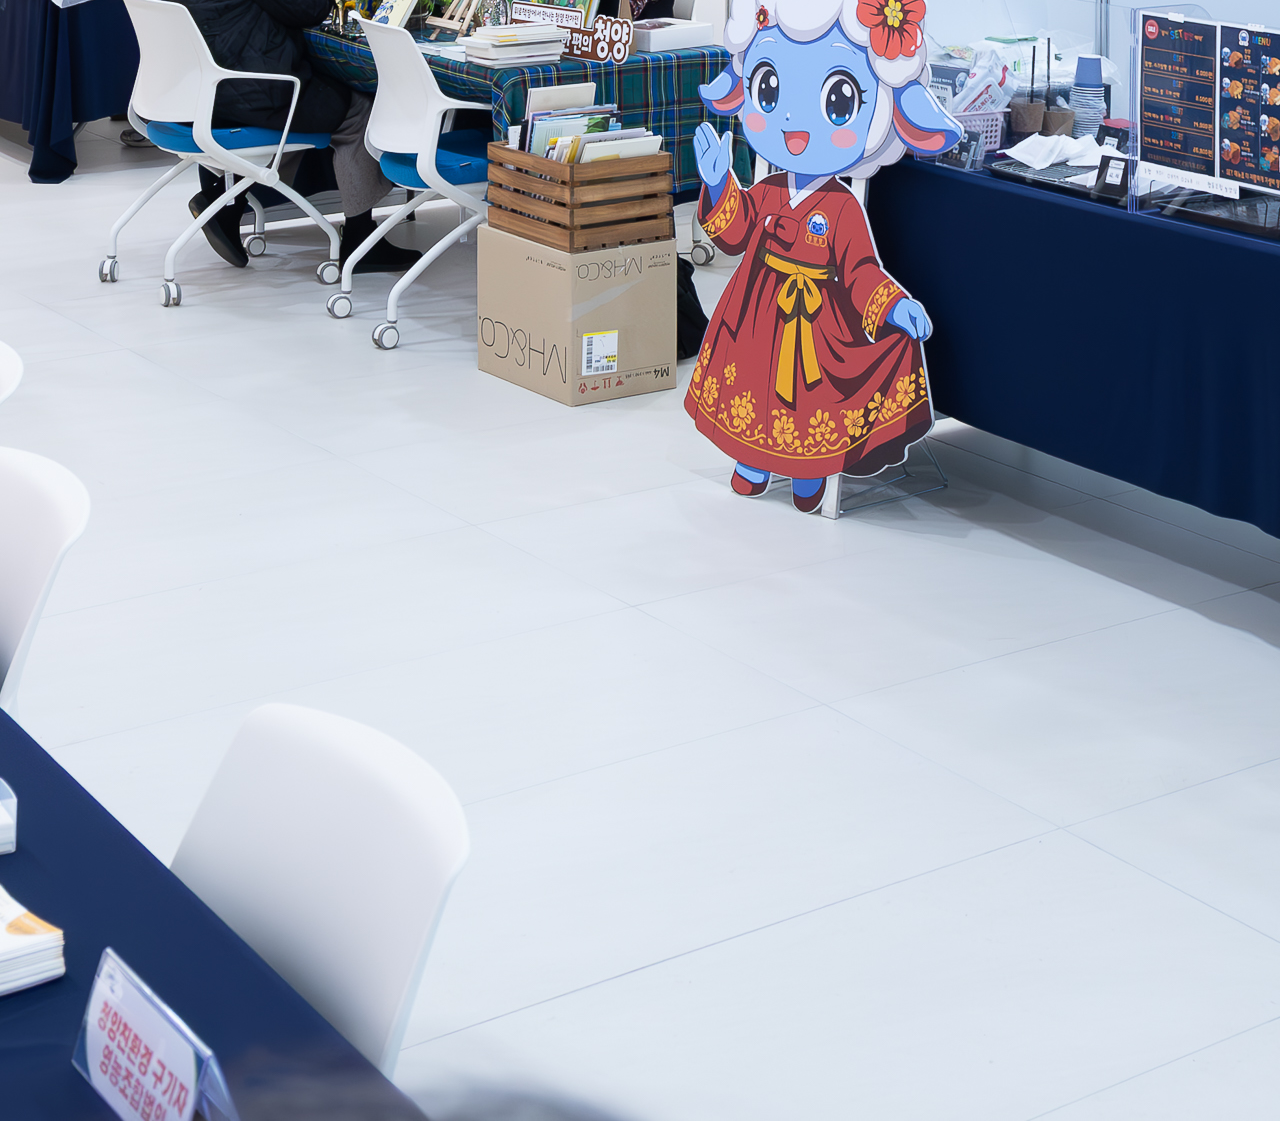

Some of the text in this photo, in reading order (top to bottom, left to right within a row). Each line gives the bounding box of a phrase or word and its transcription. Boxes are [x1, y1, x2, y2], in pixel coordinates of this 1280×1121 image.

[571, 32, 593, 55] 편의
[594, 19, 630, 61] 청양
[1170, 29, 1184, 40] SET
[1252, 35, 1271, 46] MENU
[652, 365, 670, 379] M4
[97, 1000, 189, 1118] 청양친환경 구기자
